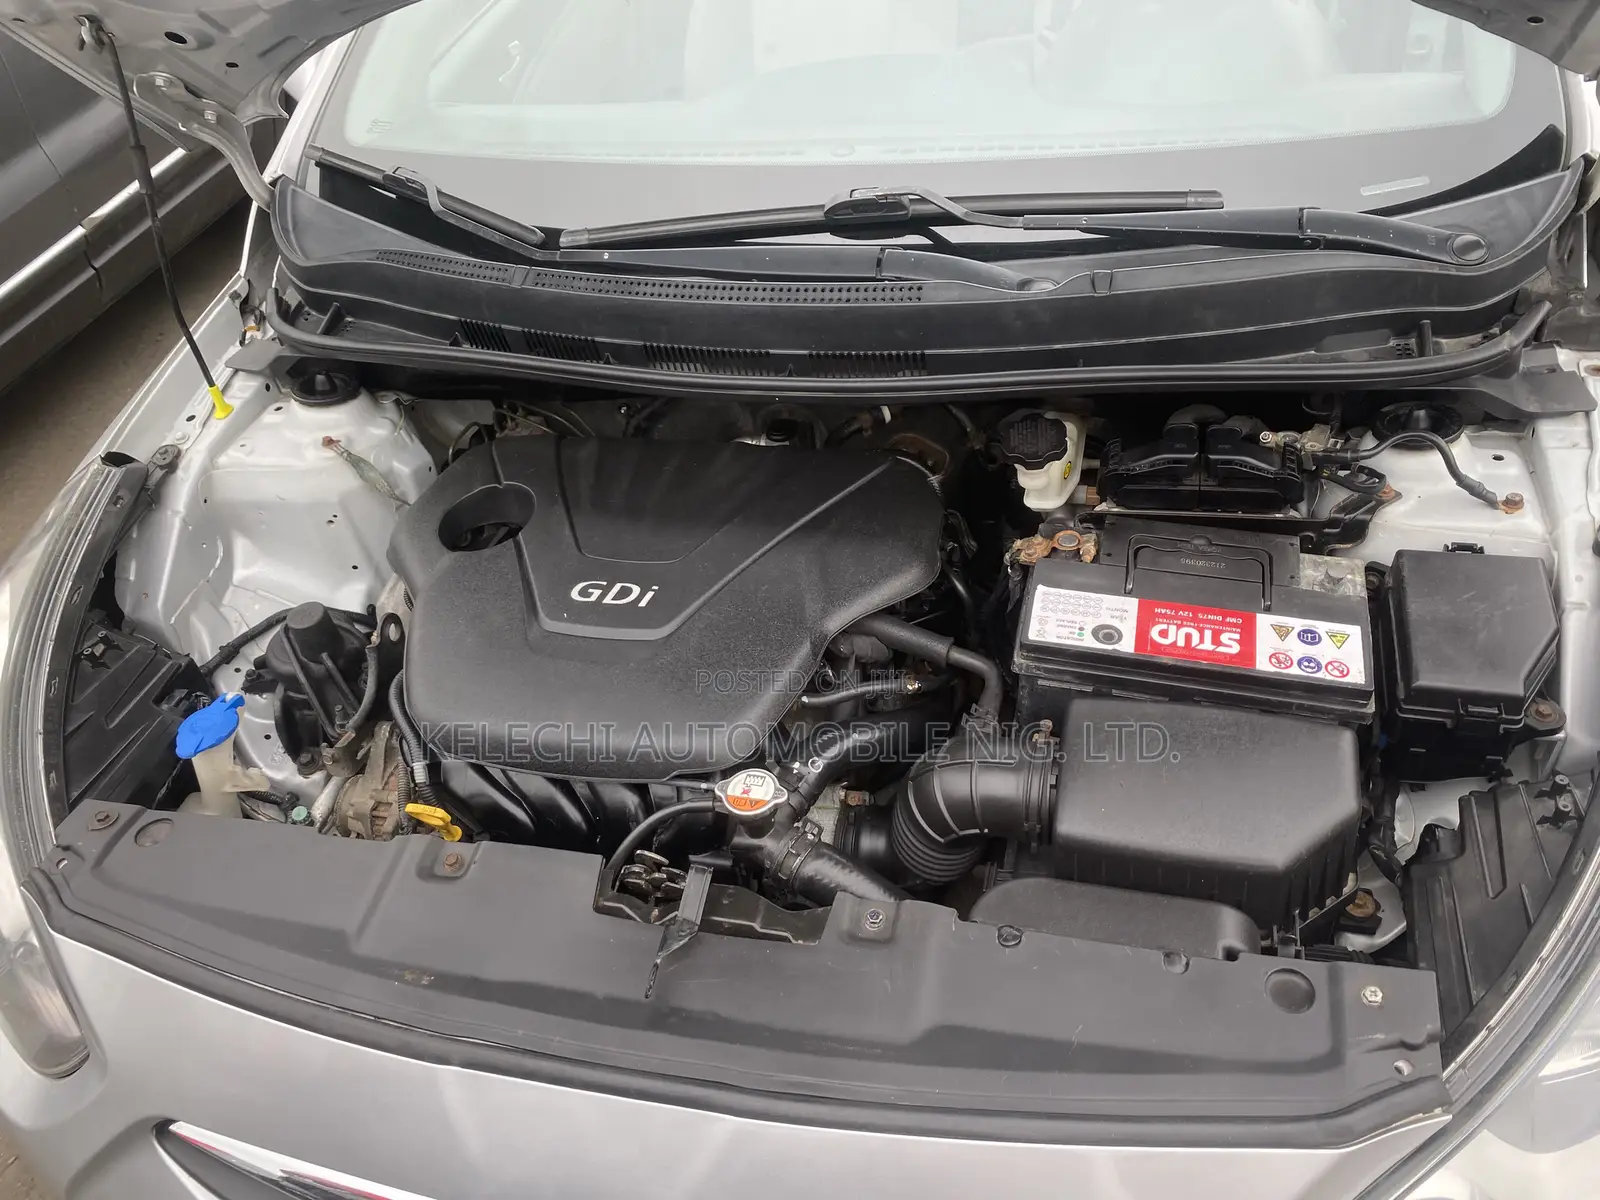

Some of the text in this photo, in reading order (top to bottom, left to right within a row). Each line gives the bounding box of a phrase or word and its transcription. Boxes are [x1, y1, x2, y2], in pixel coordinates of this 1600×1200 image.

[570, 580, 660, 607] GDi
[1154, 607, 1243, 624] CMF DIN75 12V 75AH
[1155, 617, 1182, 625] BATTERY
[1150, 623, 1241, 655] STUD
